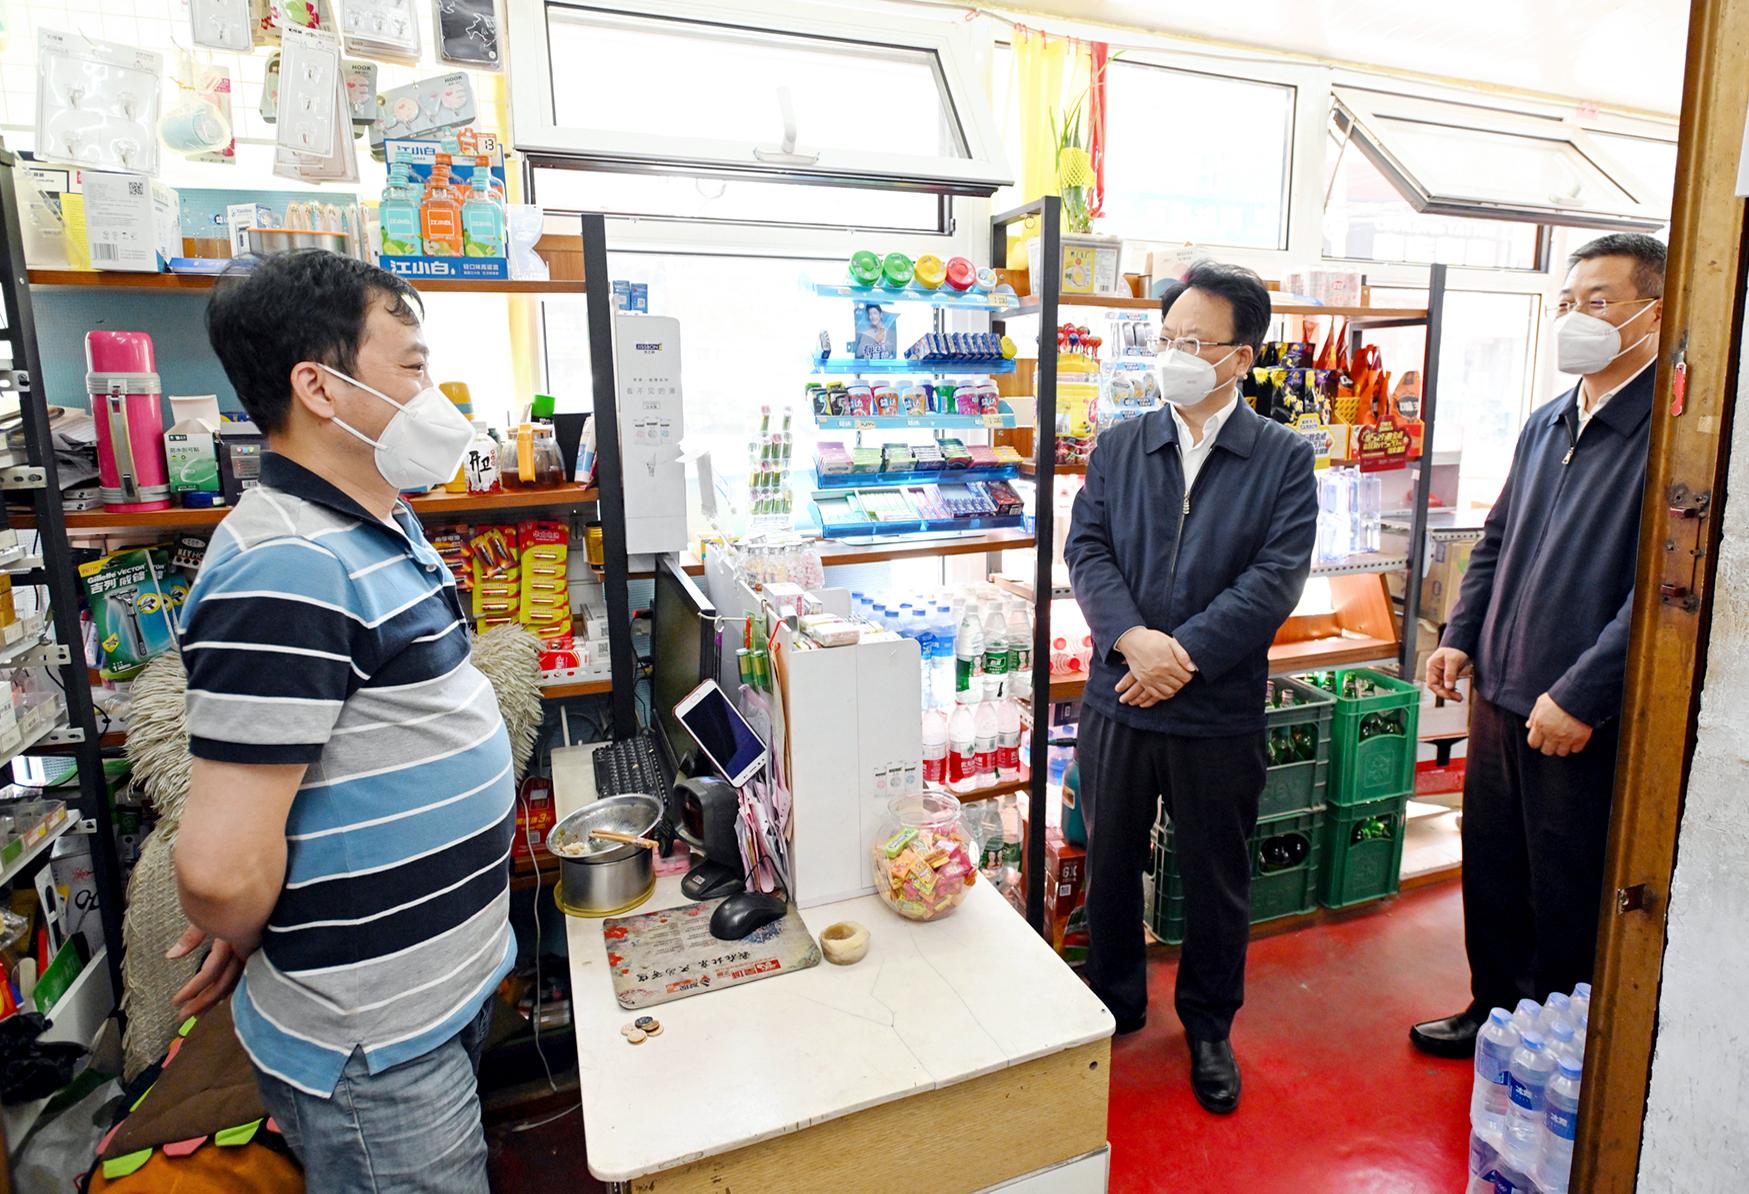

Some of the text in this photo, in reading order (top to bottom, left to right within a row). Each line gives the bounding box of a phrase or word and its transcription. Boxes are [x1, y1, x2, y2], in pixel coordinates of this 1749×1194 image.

[390, 259, 449, 275] 江小白
[87, 571, 117, 584] Gillette
[117, 563, 145, 576] VECTOR
[90, 577, 117, 595] 吉列
